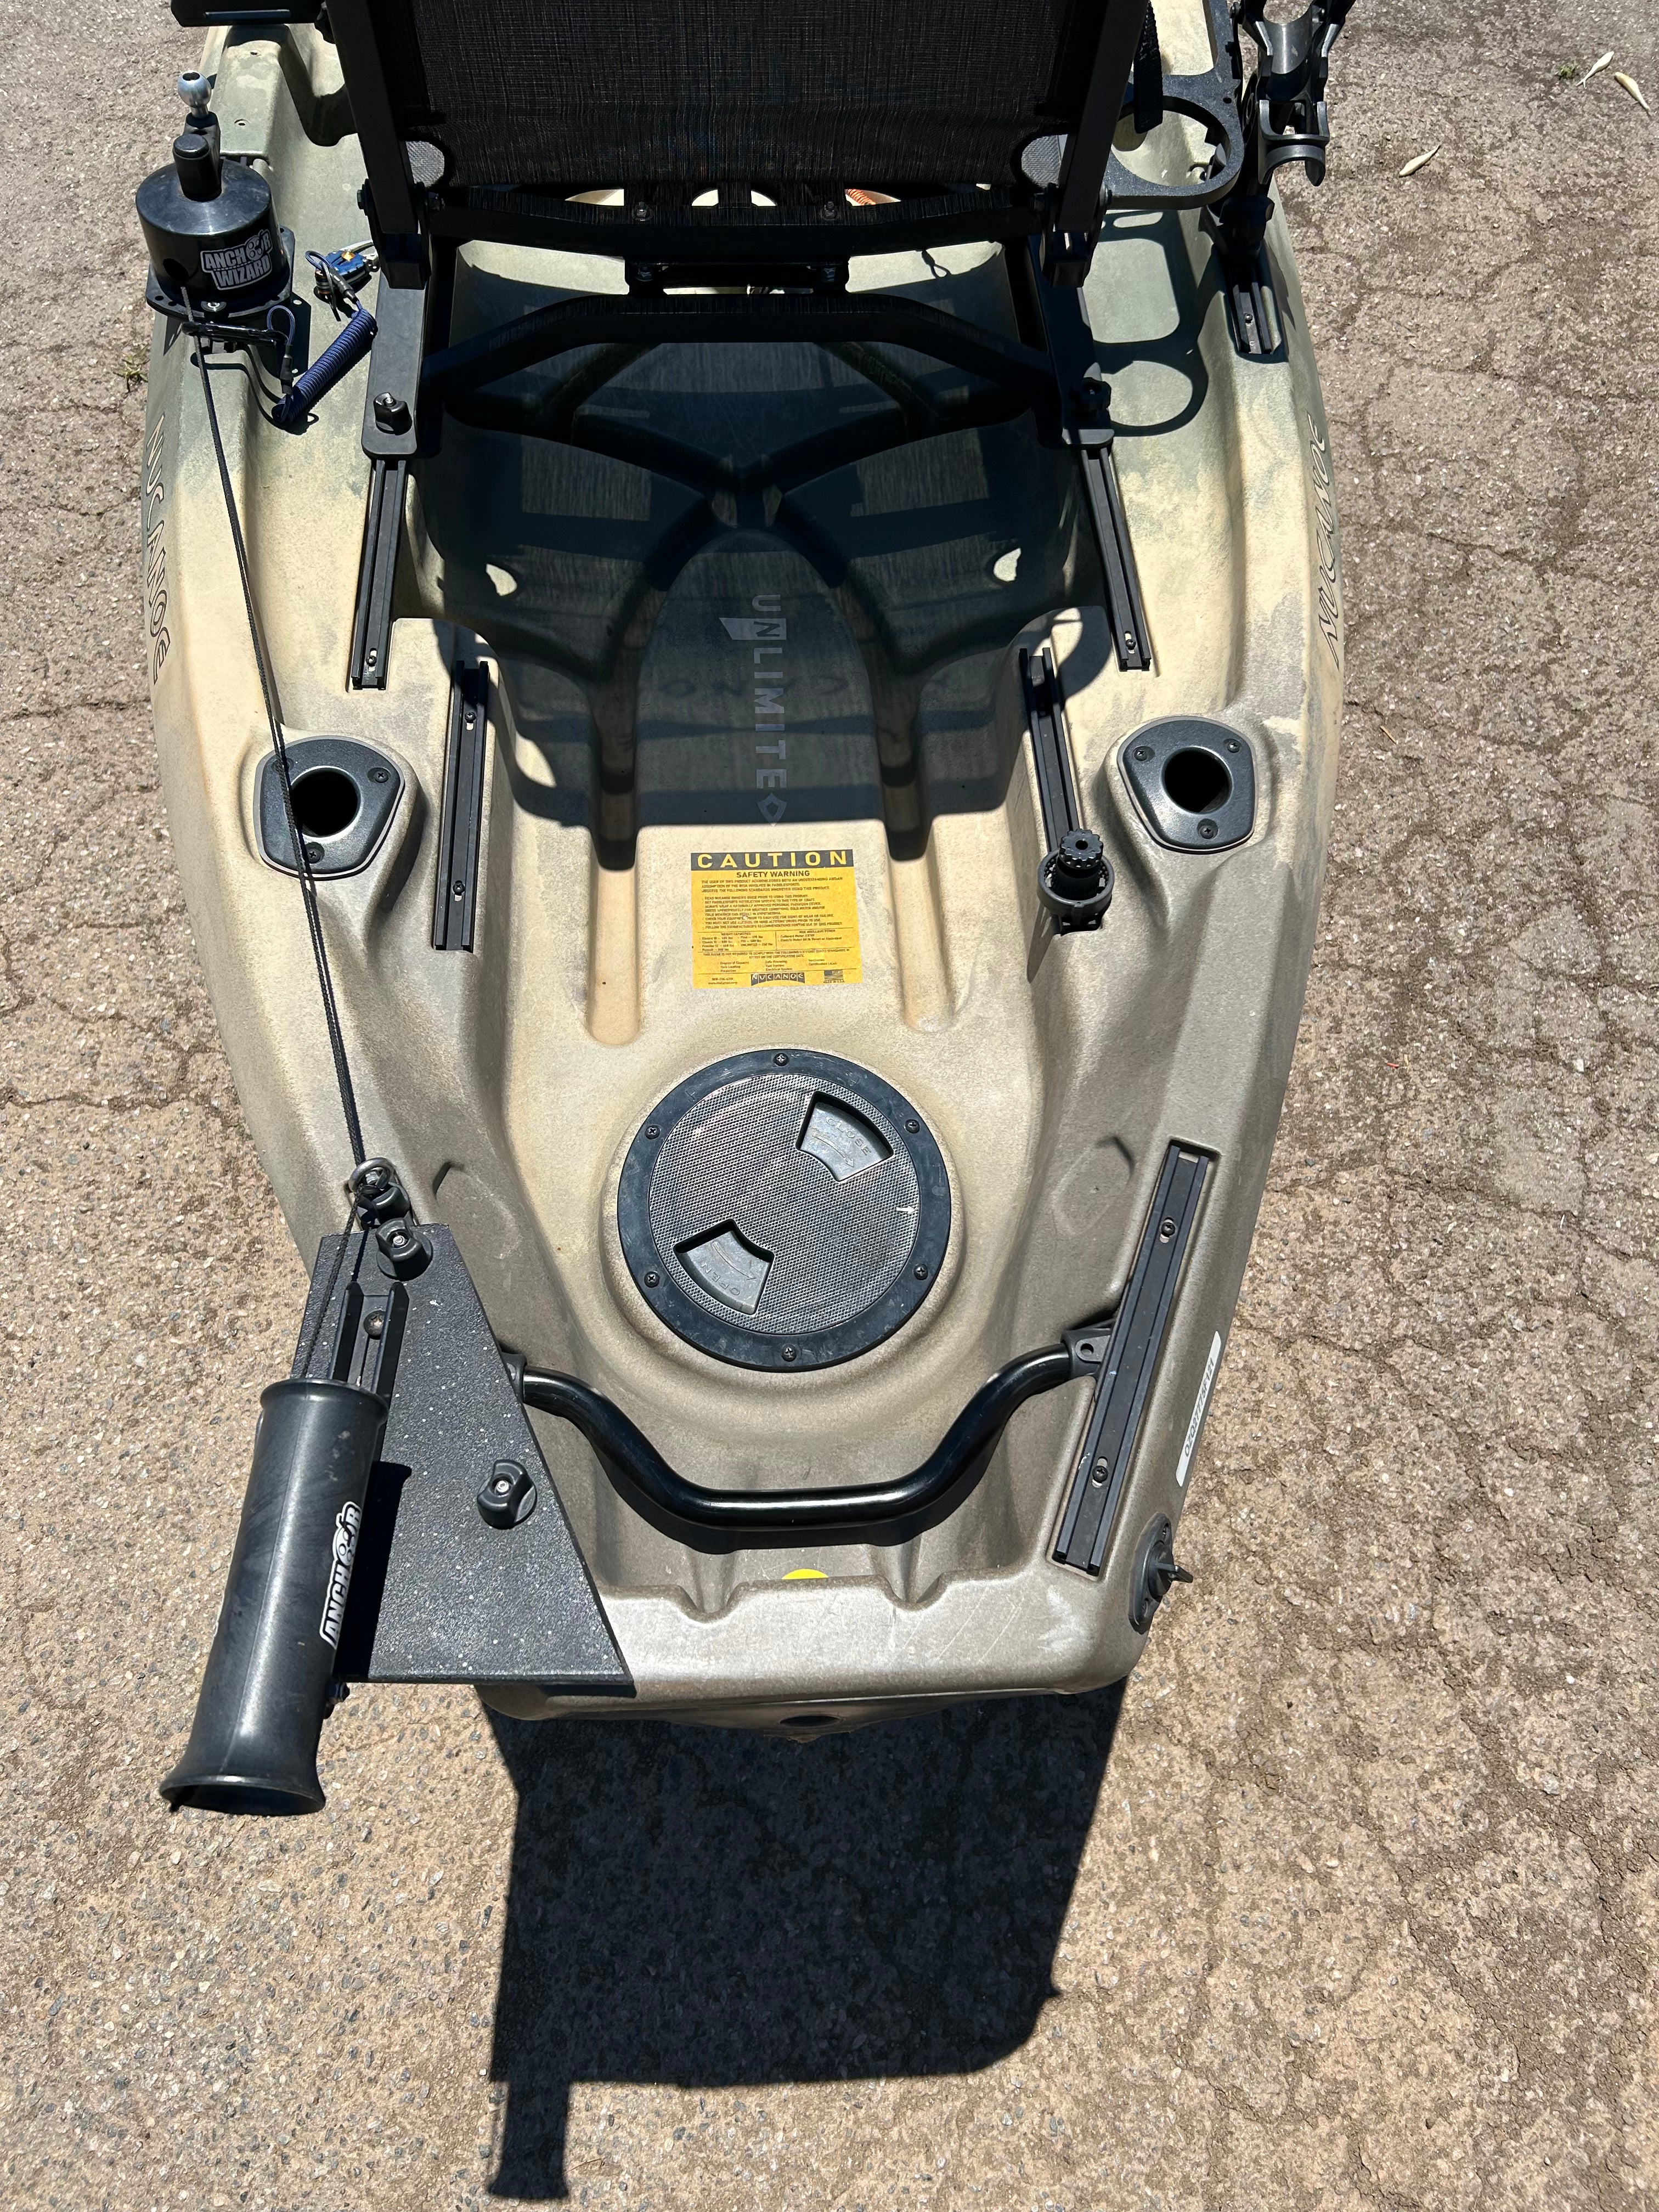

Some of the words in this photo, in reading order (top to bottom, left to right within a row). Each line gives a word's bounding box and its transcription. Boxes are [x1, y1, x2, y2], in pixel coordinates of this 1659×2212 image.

[215, 254, 271, 289] WIZARD
[697, 851, 847, 868] CAUTION
[752, 973, 804, 983] NUCANOE
[825, 1116, 872, 1156] CLOSE
[701, 1262, 741, 1296] OPEN
